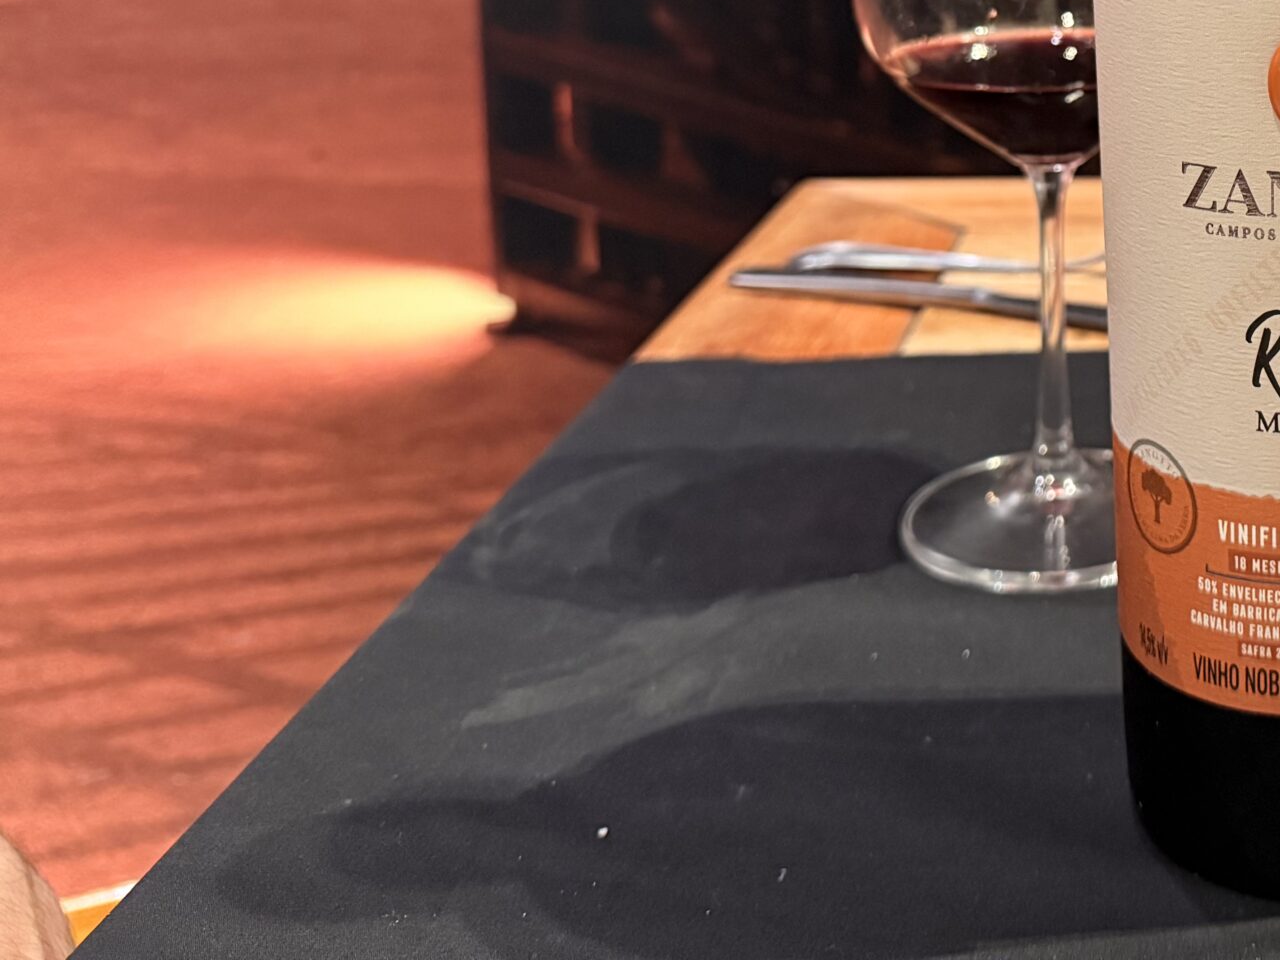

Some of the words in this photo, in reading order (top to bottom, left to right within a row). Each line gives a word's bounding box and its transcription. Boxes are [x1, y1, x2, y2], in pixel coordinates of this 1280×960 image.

[1205, 222, 1277, 241] CAMPOS
[1234, 555, 1247, 571] 18
[1198, 576, 1218, 595] 50%
[1212, 598, 1228, 615] EM
[1190, 608, 1244, 637] CARVALHO
[1241, 642, 1272, 658] SAFRA
[1193, 652, 1240, 691] VINHO
